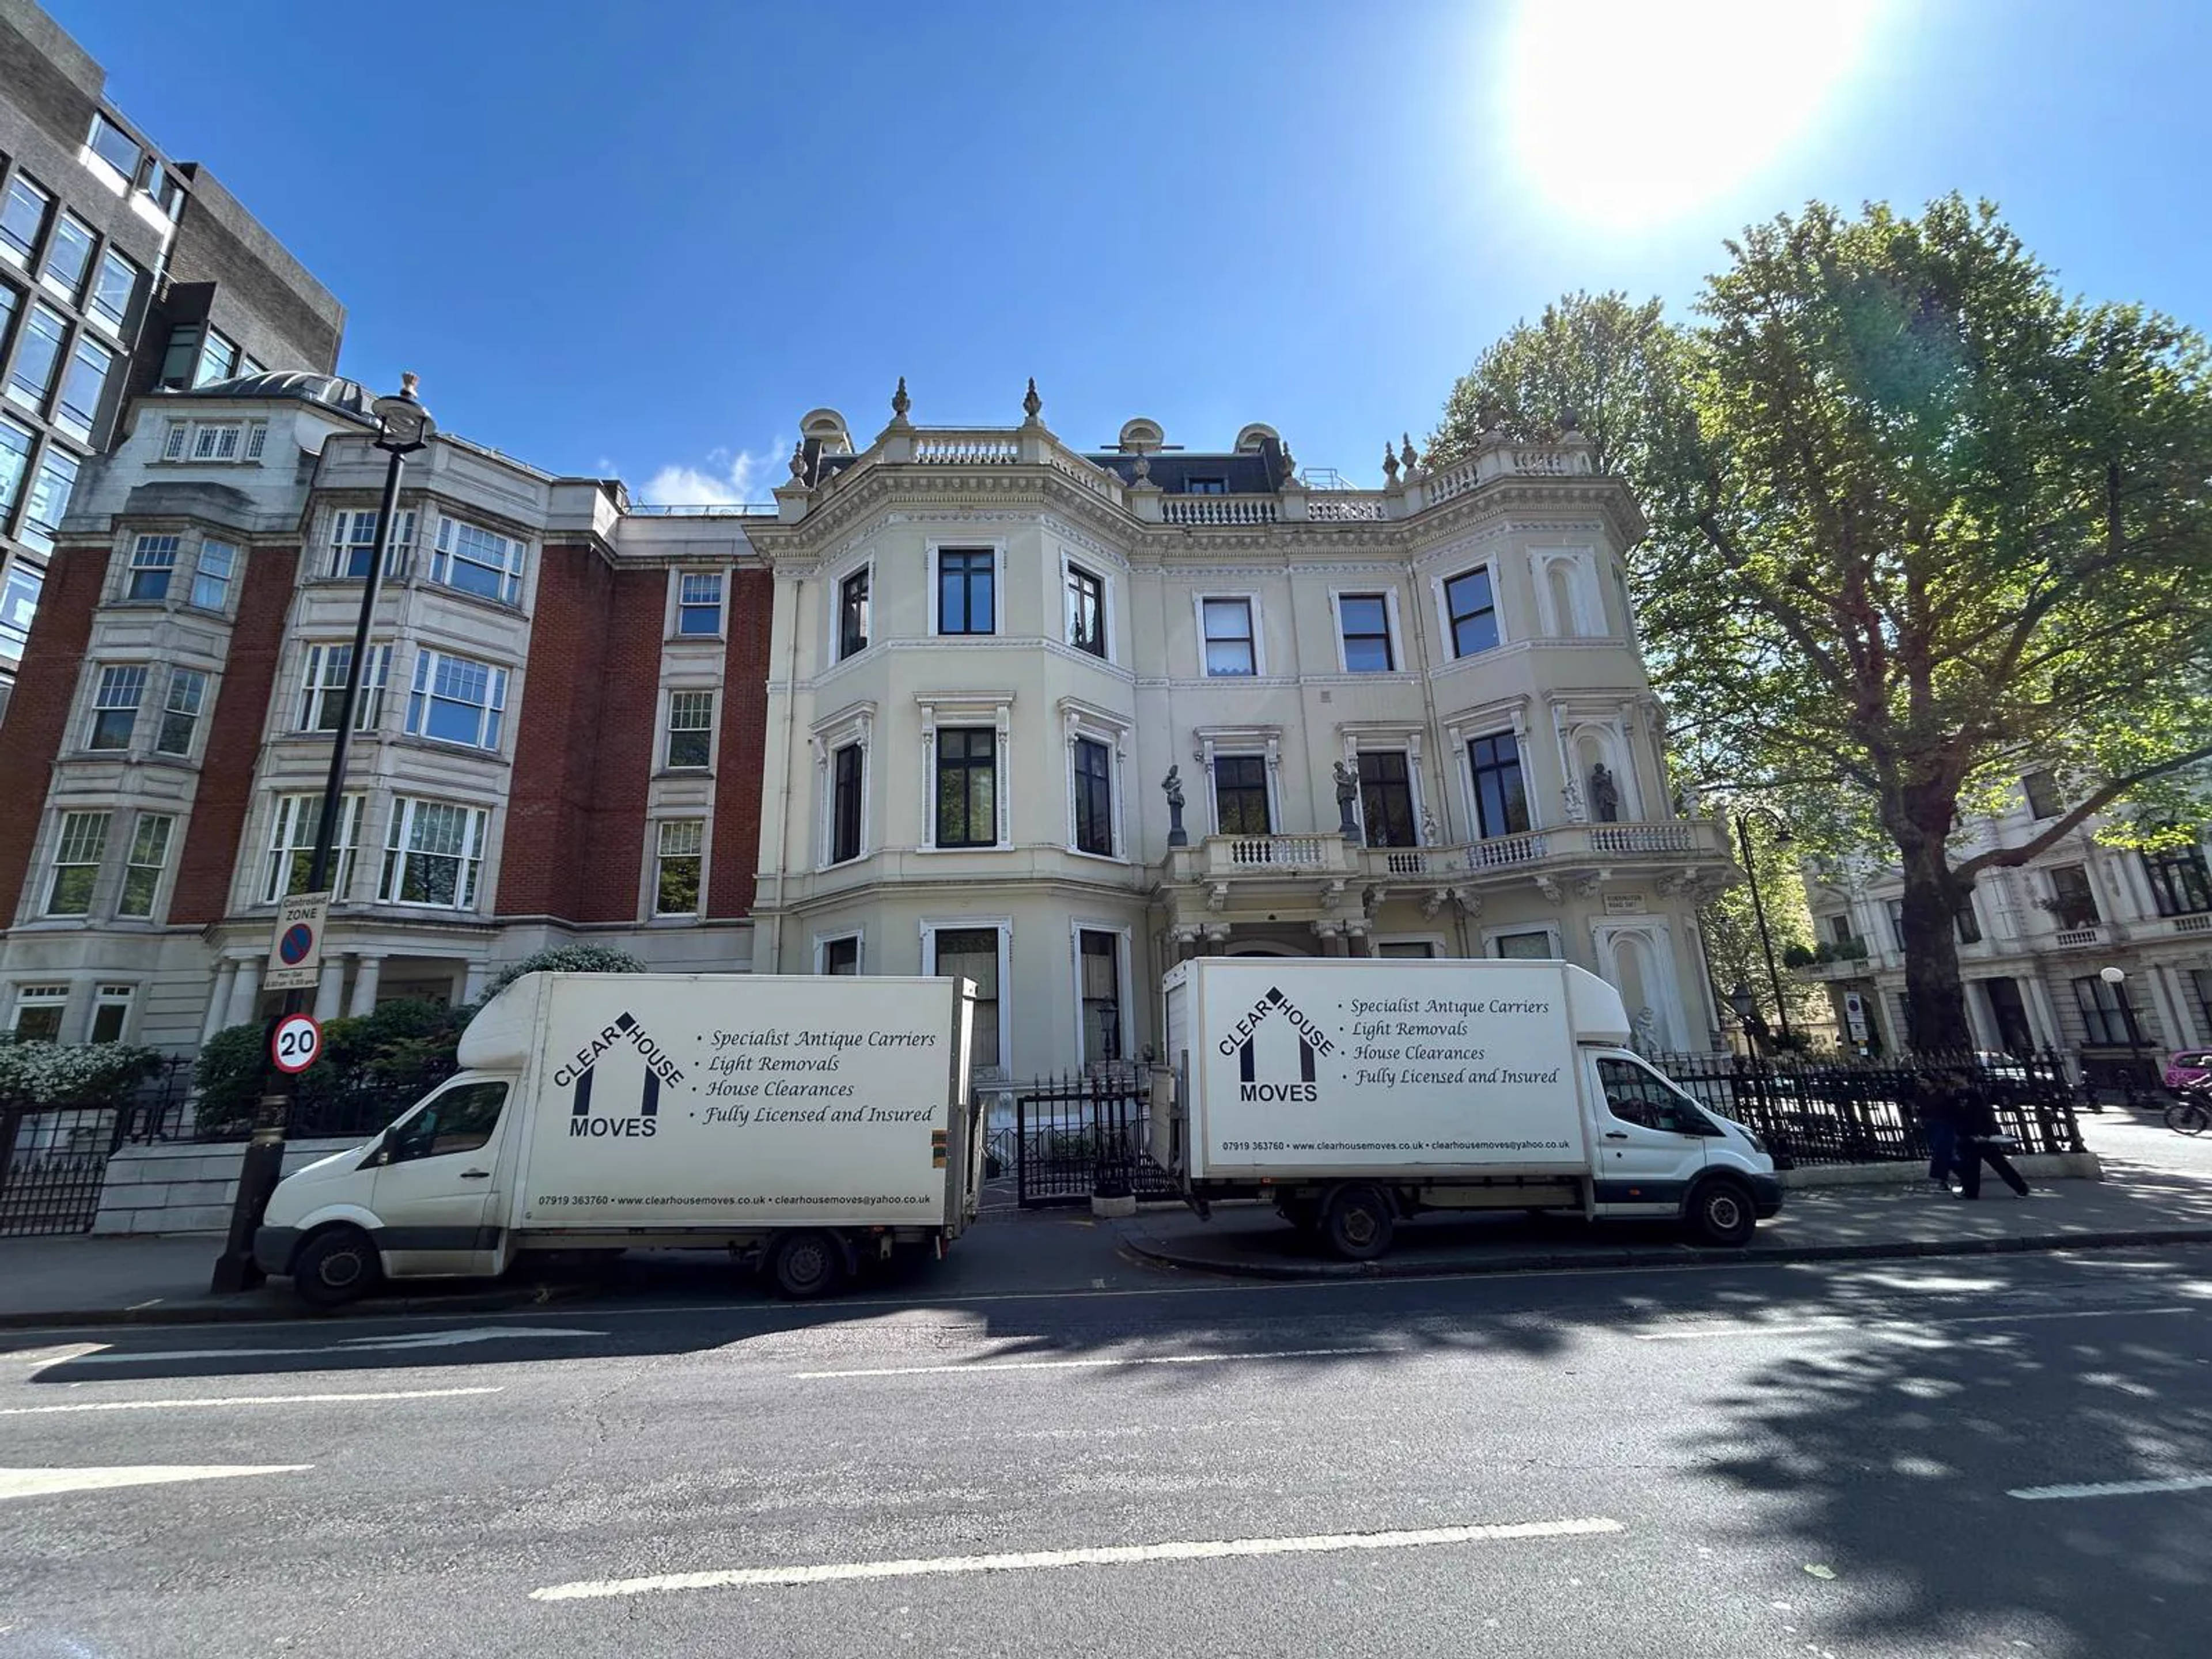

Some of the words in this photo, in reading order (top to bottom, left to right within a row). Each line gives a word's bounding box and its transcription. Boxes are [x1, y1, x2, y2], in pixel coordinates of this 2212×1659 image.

[286, 908, 317, 921] ZONE
[1351, 998, 1419, 1017] Specialist
[1425, 999, 1484, 1017] Antique
[1490, 999, 1549, 1013] Carriers
[1219, 999, 1273, 1056] CLEAR
[1277, 998, 1335, 1057] HOUSE
[1352, 1020, 1391, 1040] Light
[1396, 1020, 1468, 1035] Removals
[281, 1030, 315, 1056] 20
[711, 1029, 789, 1050] Specialist
[794, 1031, 862, 1051] Antique
[868, 1031, 935, 1046] Carriers
[554, 1025, 621, 1087] CLEAR
[626, 1024, 684, 1088] HOUSE
[1354, 1044, 1400, 1059] House
[1406, 1044, 1485, 1059] Clearances
[709, 1055, 752, 1075] Light
[758, 1055, 839, 1071] Removals
[1355, 1067, 1395, 1088] Fully
[1400, 1067, 1466, 1083] Licensed
[1469, 1067, 1499, 1083] and
[1501, 1067, 1560, 1084] Insured
[706, 1080, 759, 1096] House
[764, 1080, 854, 1096] Clearances
[1240, 1084, 1317, 1101] MOVES
[702, 1105, 749, 1127] Fully
[754, 1105, 831, 1122] Licensed
[831, 1105, 868, 1122] and
[868, 1105, 937, 1122] Insured
[570, 1118, 657, 1137] MOVES
[1222, 1142, 1249, 1150] 07919
[1252, 1142, 1284, 1150] 363760
[1293, 1141, 1423, 1150] www.clearhousemoves.co.uk
[1431, 1141, 1570, 1150] clearhousemoves@yahoo.co.uk
[539, 1196, 569, 1205] 07919
[572, 1196, 608, 1205] 363760
[618, 1196, 766, 1205] www.clearhousemoves.co.uk
[775, 1195, 930, 1206] clearhousemoves@yahoo.co.uk
